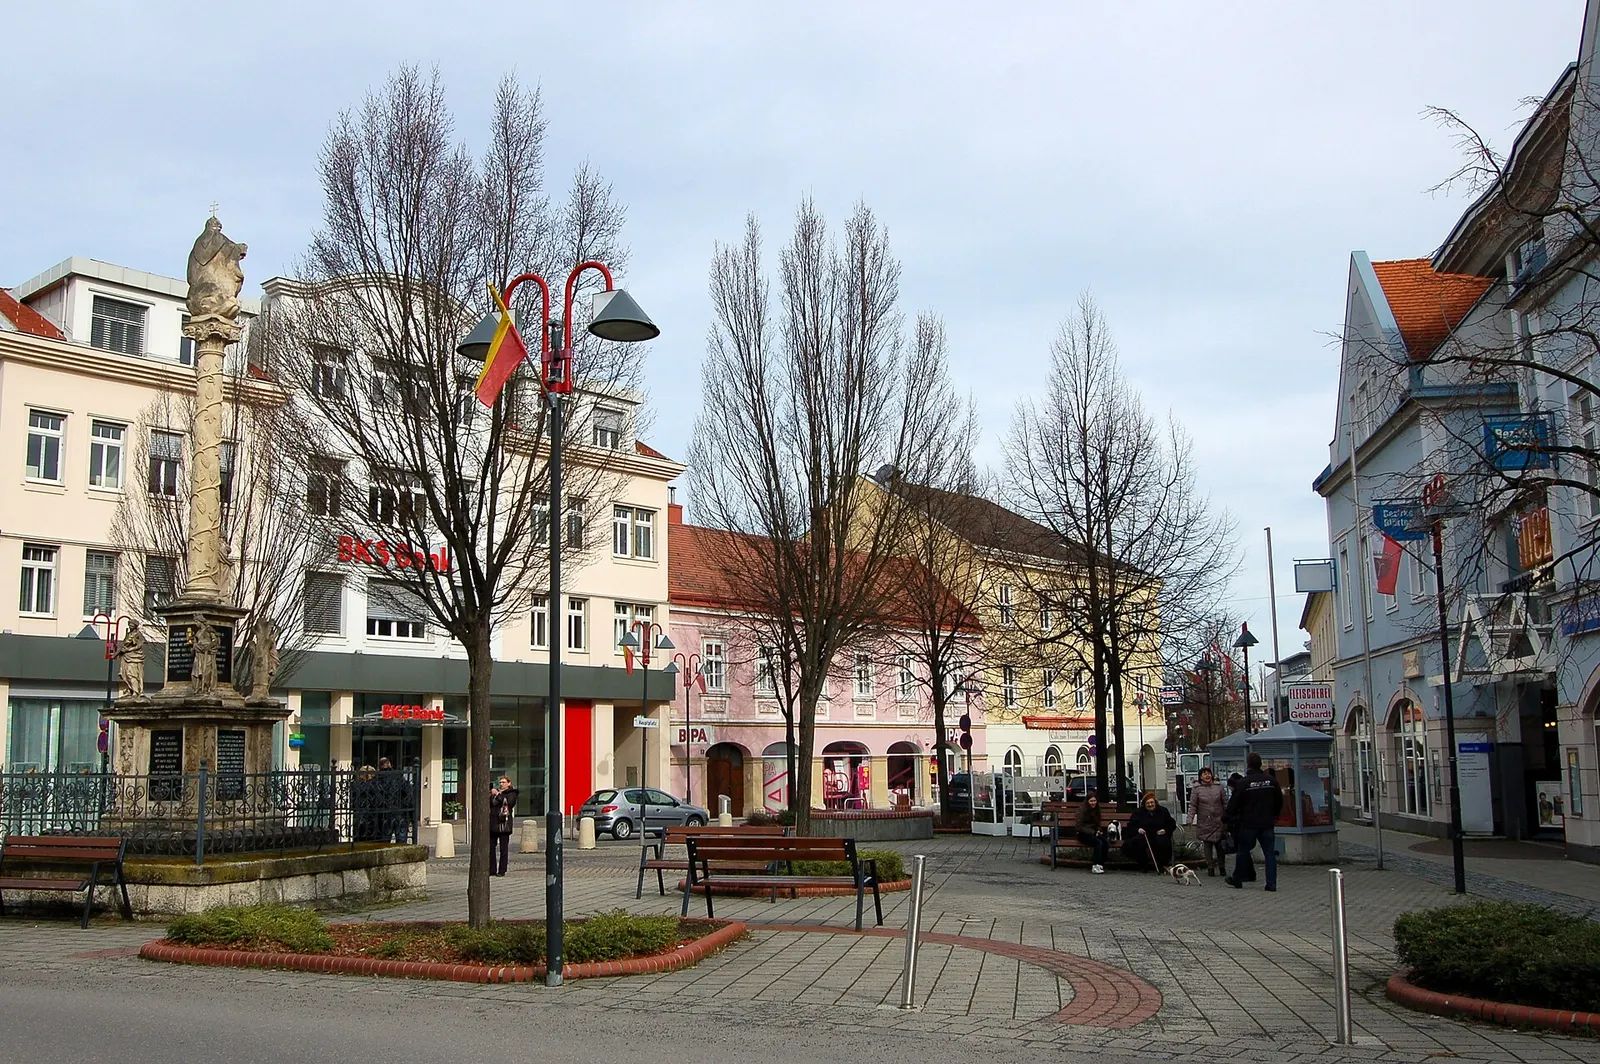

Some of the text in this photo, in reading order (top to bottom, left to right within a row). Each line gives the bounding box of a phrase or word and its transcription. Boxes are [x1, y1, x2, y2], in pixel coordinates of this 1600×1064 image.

[338, 535, 390, 566] BKS
[1290, 687, 1331, 699] FLEISCHEREI
[381, 704, 444, 720] BKS Bank
[1294, 702, 1327, 710] Johann
[1290, 710, 1332, 719] Gebhardt
[678, 728, 708, 742] BPA
[763, 761, 776, 777] PA
